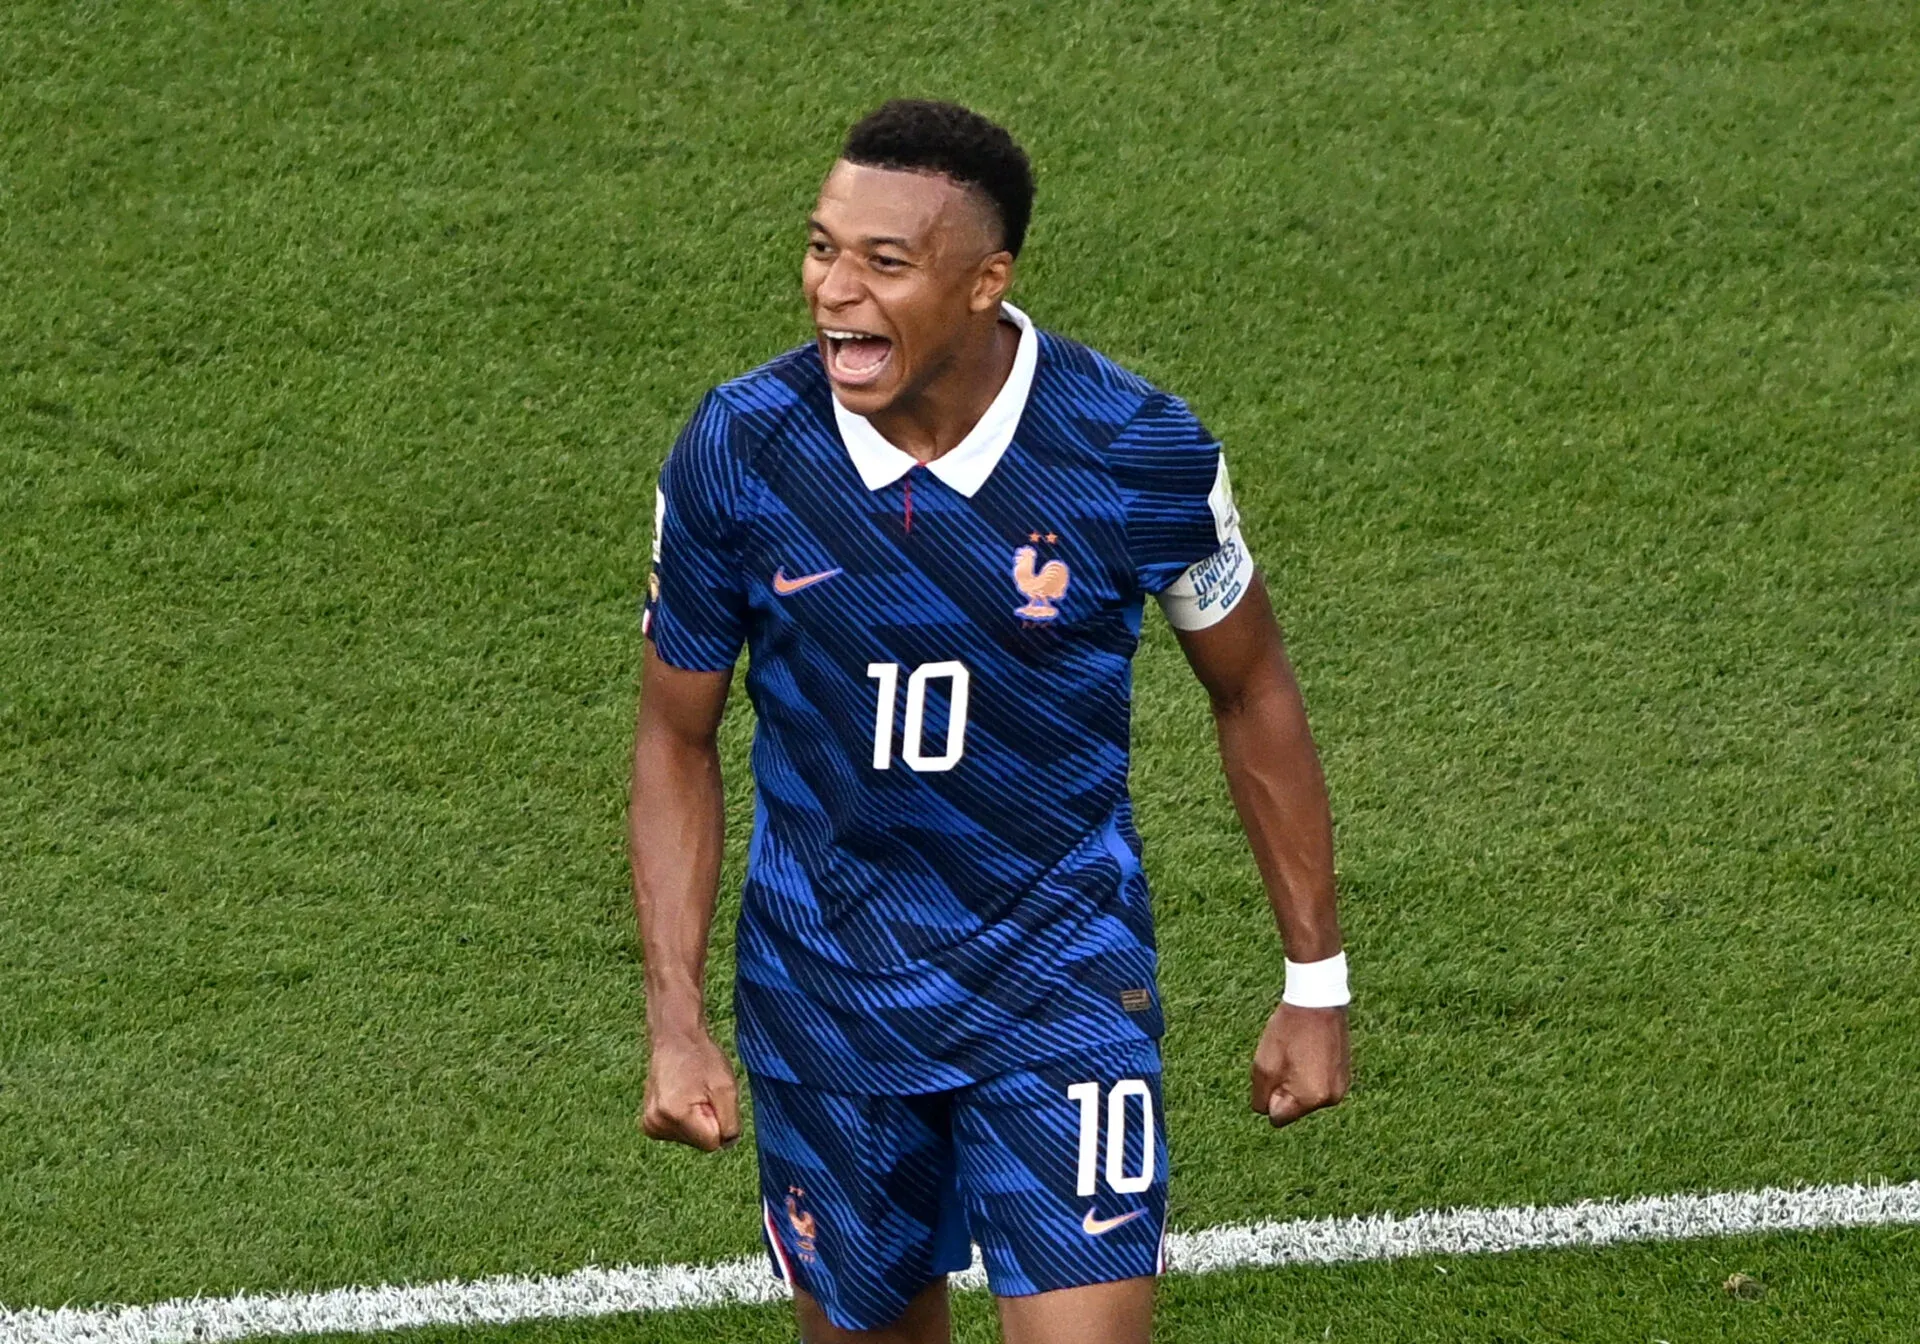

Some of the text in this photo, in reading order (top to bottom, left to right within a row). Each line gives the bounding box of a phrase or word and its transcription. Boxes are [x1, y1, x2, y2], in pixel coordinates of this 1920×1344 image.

[1194, 541, 1236, 596] UNITES
[867, 660, 970, 772] 10
[1067, 1079, 1155, 1197] 10
